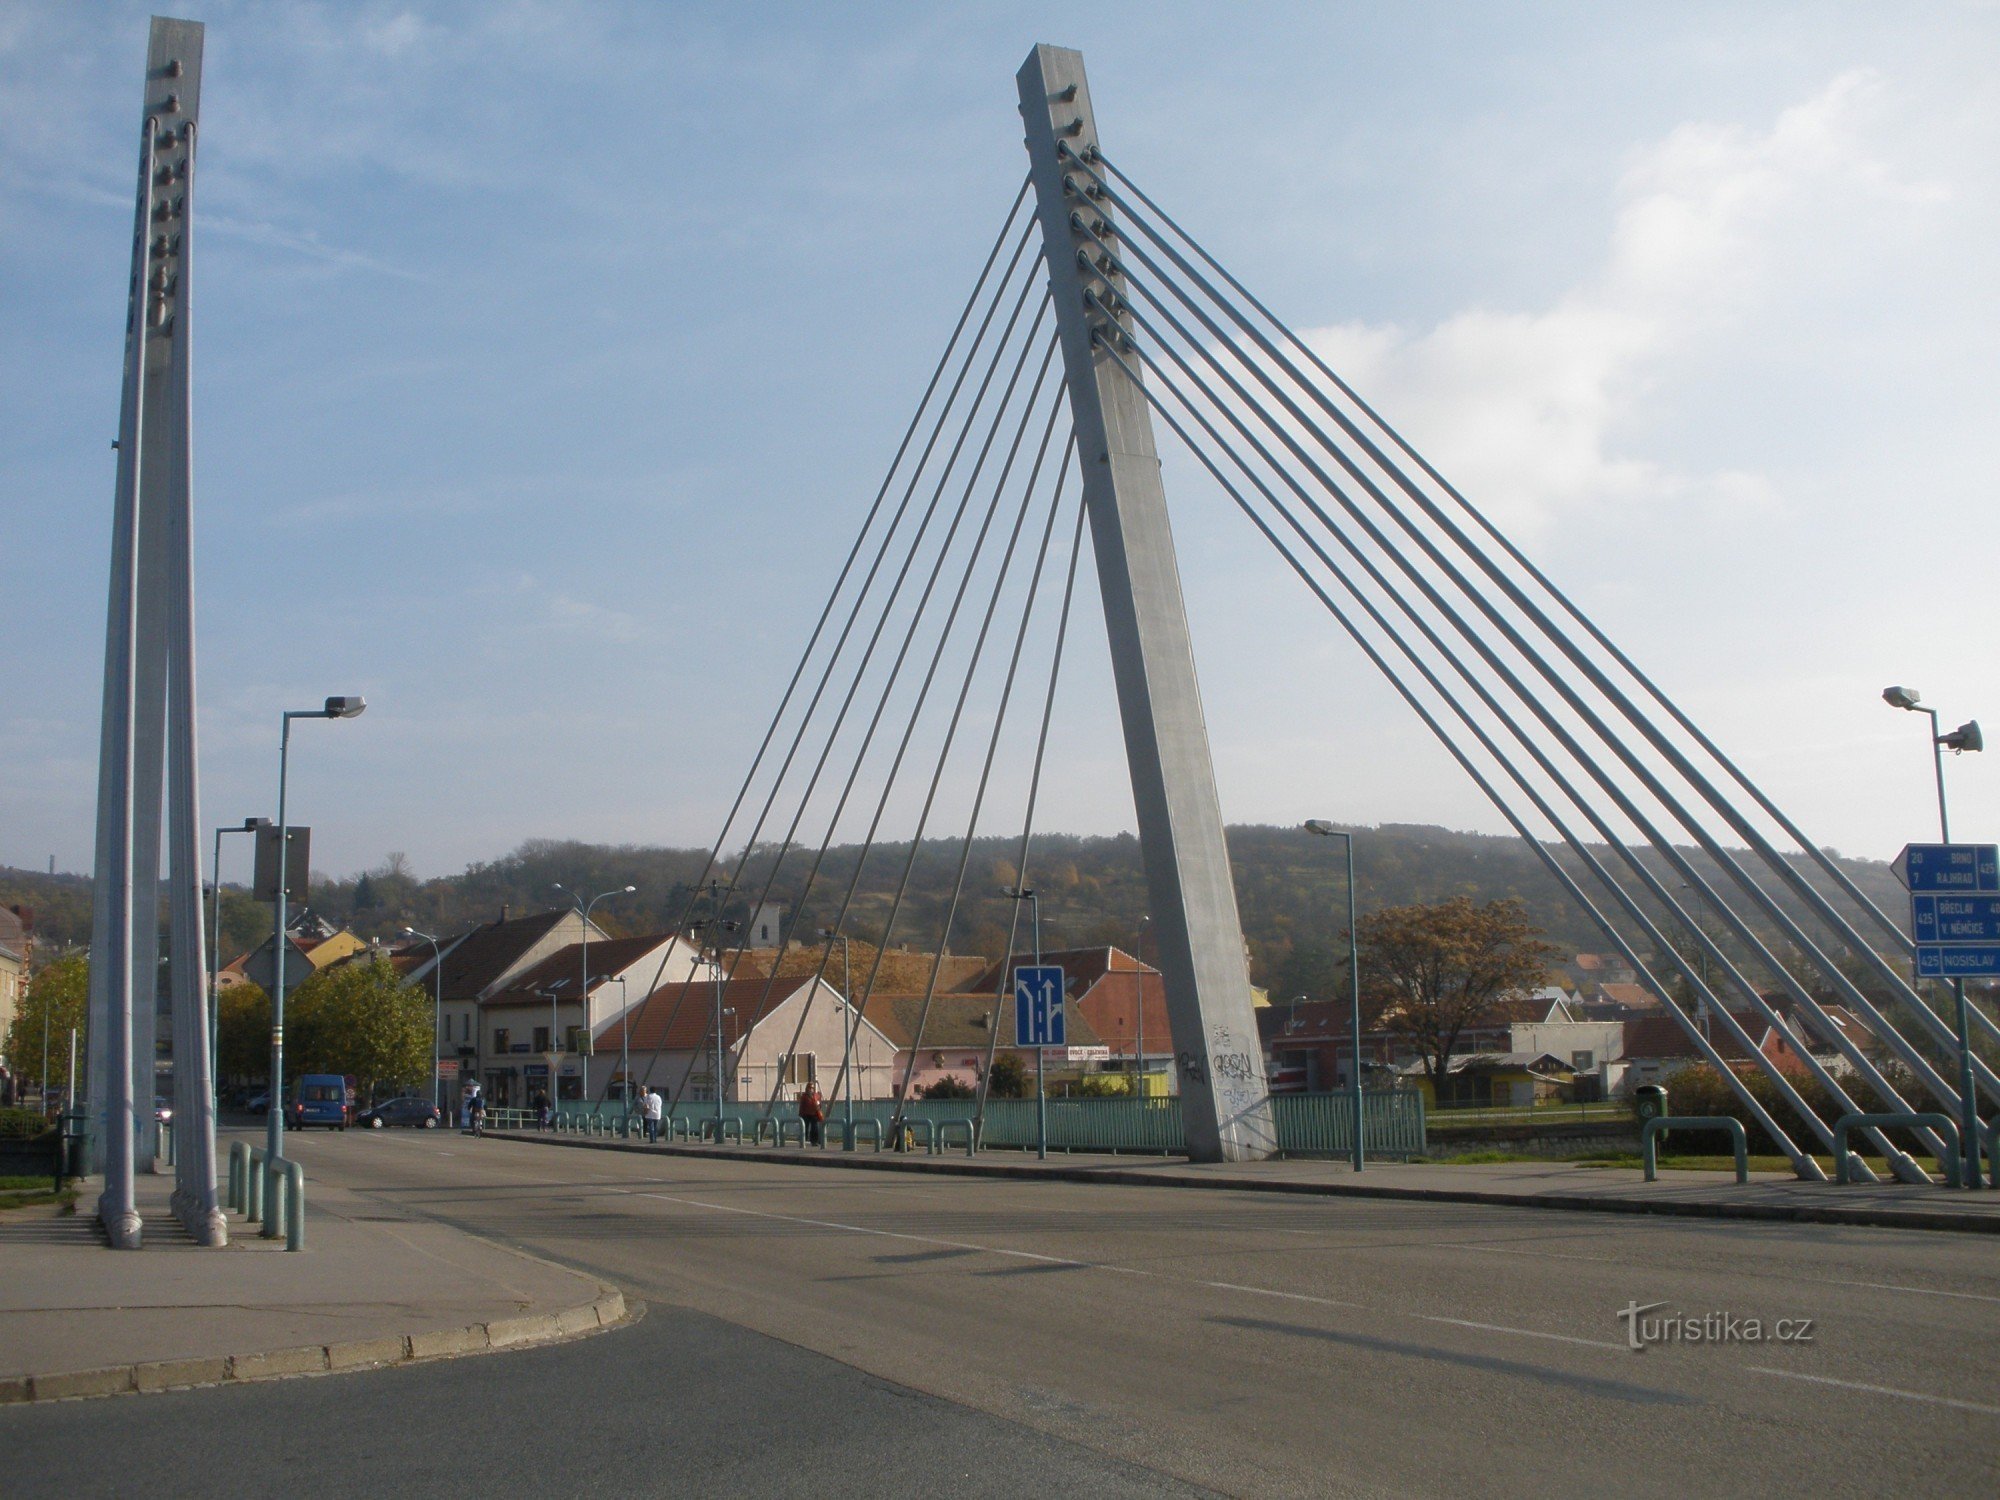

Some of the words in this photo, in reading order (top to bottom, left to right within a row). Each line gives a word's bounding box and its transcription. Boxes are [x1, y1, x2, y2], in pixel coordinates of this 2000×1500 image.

[1911, 852, 1923, 864] 20
[1951, 852, 1972, 864] BRNO
[1980, 863, 1995, 874] 425
[1913, 872, 1919, 884] 7
[1936, 872, 1973, 884] RAJHRAD
[1940, 900, 1974, 914] BŘECLAV
[1917, 913, 1933, 925] 425
[1921, 955, 1939, 967] 425
[1944, 955, 1995, 967] NOSISLAV
